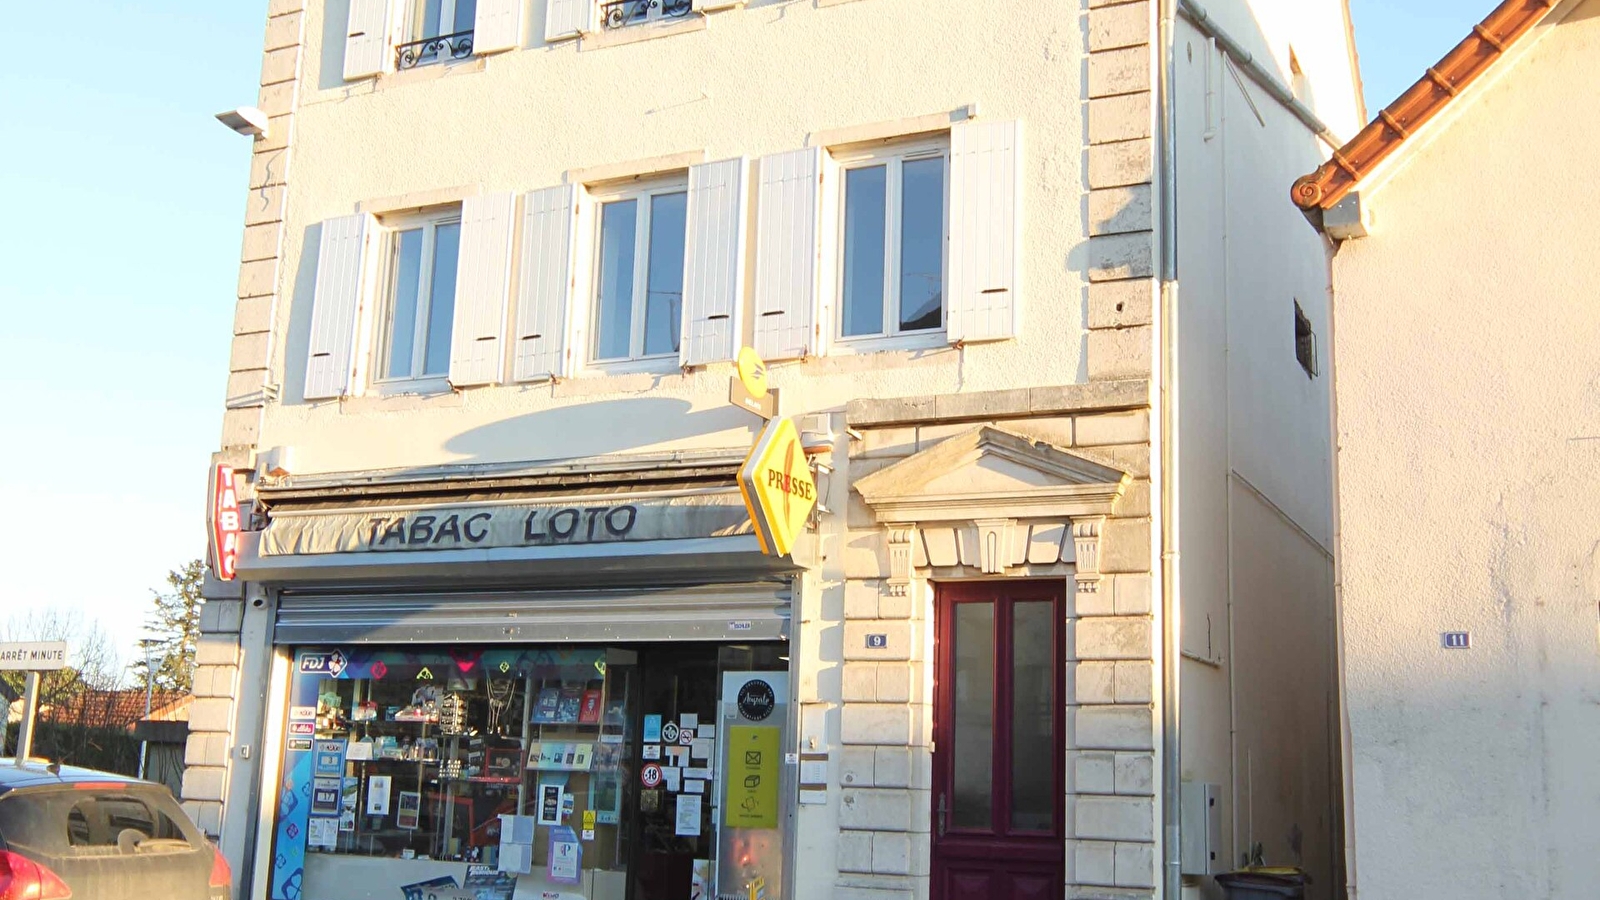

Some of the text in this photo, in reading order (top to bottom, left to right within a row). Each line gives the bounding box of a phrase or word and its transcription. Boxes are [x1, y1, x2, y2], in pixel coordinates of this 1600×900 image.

[768, 468, 812, 500] PRESSE
[220, 466, 239, 575] TABAC
[368, 505, 637, 546] TABAC LOTO
[874, 636, 881, 646] 9
[1452, 634, 1464, 646] 11
[0, 649, 63, 661] ARRÊT MINUTE
[302, 657, 325, 669] FDJ
